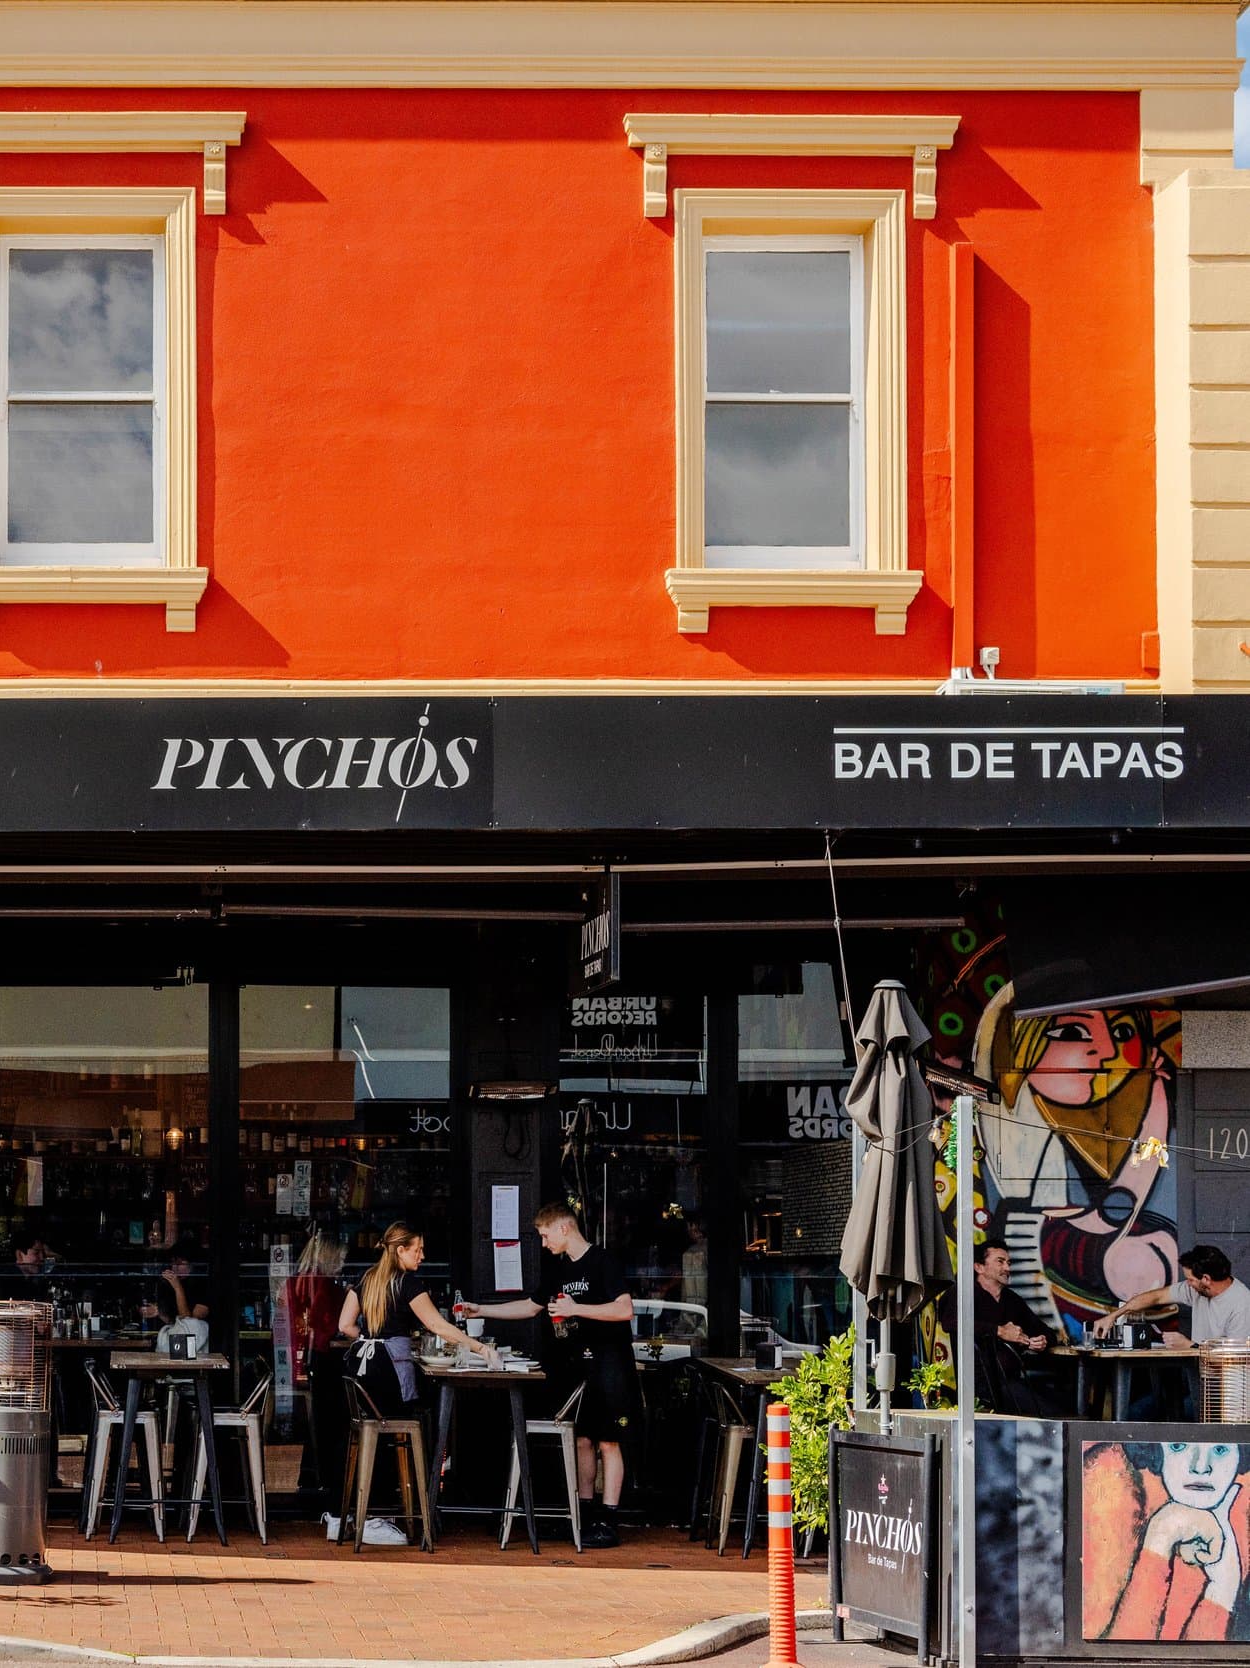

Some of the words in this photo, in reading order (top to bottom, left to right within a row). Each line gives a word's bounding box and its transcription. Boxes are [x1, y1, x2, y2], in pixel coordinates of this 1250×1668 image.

[834, 742, 932, 779] BAR
[950, 742, 1015, 779] DE
[1030, 740, 1185, 779] TAPAS
[1210, 1127, 1248, 1159] 120
